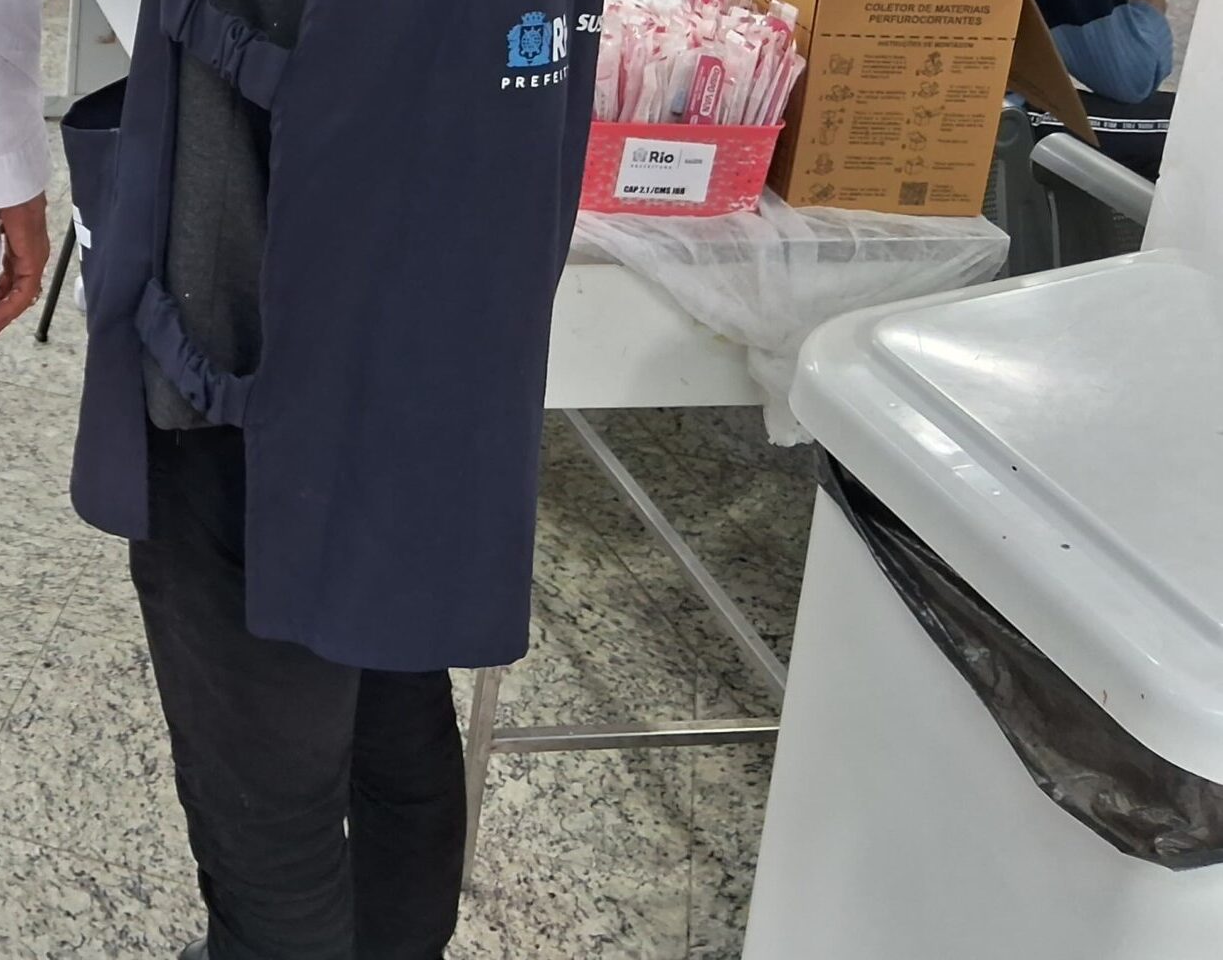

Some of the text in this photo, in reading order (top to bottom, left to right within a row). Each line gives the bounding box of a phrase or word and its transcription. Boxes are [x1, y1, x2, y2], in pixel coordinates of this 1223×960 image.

[864, 2, 991, 14] COLETOR DE MATERIAIS
[868, 14, 983, 26] PERFUROCORTANTES
[648, 150, 675, 163] Rio
[623, 185, 639, 194] CAP
